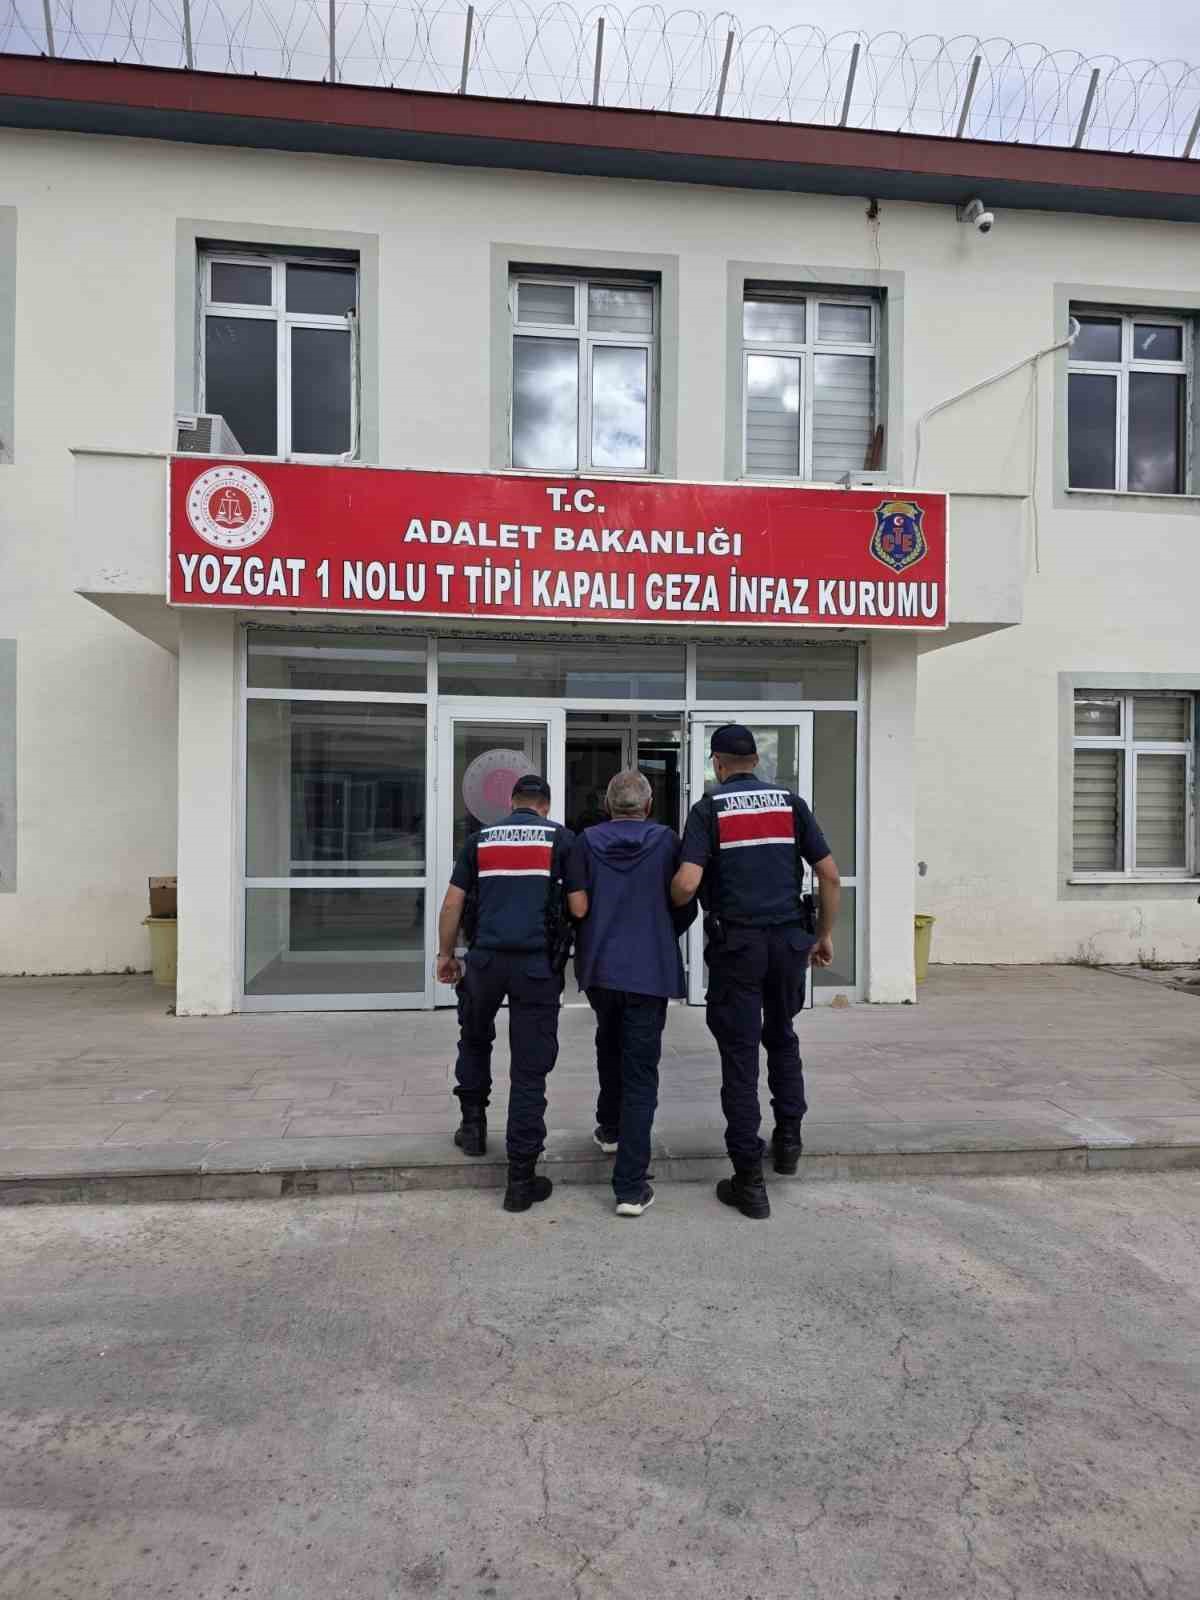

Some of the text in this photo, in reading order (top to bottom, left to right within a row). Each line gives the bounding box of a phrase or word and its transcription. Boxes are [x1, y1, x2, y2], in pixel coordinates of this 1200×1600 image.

[546, 487, 606, 513] T.C.
[404, 518, 742, 556] ADALET BAKANLIĞI
[177, 553, 938, 618] YOZGAT 1 NOLU T TİPİ KAPALI CEZA İNFAZ KURUMU
[724, 793, 786, 810] JANDARMA
[485, 829, 546, 842] JANDARMA
